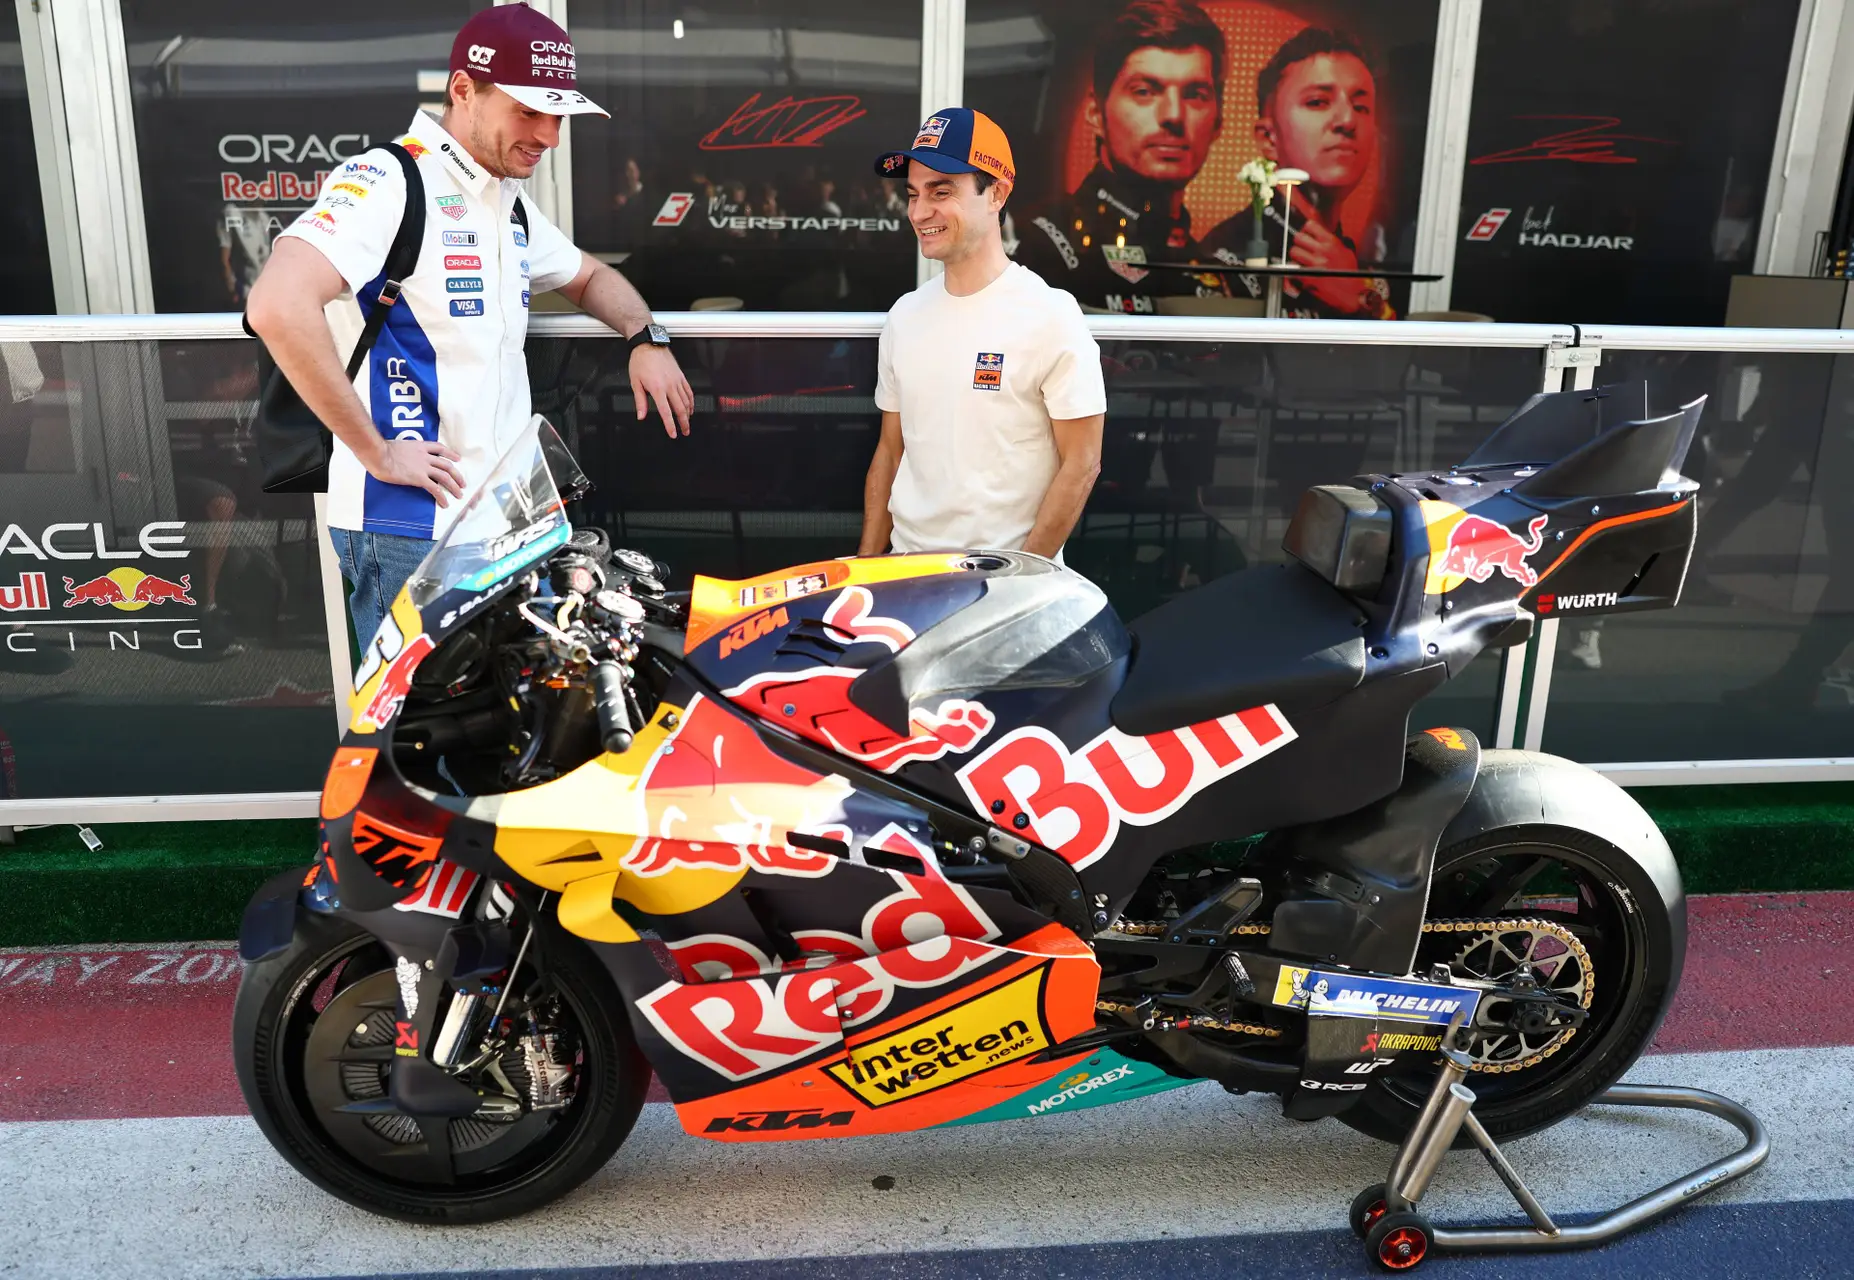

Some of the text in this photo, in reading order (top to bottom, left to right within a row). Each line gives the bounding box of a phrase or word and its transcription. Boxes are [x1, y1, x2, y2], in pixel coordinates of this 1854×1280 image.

[531, 54, 567, 68] Red Bull
[345, 163, 386, 177] Mobil
[974, 151, 1002, 171] FACTORY
[221, 171, 278, 200] Red
[438, 198, 463, 206] TAG
[708, 215, 901, 231] VERSTAPPEN
[445, 233, 467, 244] Mobil
[1518, 232, 1634, 250] HADJAR
[446, 259, 480, 267] ORACLE
[448, 281, 482, 289] CARLYLE
[454, 300, 476, 311] VISA
[978, 373, 998, 382] KTM
[1557, 592, 1618, 610] WÜRTH
[719, 606, 790, 660] KTM
[635, 822, 1003, 1082] Red
[1334, 989, 1461, 1014] MICHELIN
[845, 1026, 955, 1086] Inter
[873, 1018, 1030, 1096] wetten
[537, 1060, 551, 1097] brembo
[1322, 1082, 1367, 1092] RCB
[1027, 1063, 1135, 1115] MOTOREX
[703, 1109, 855, 1134] KTM
